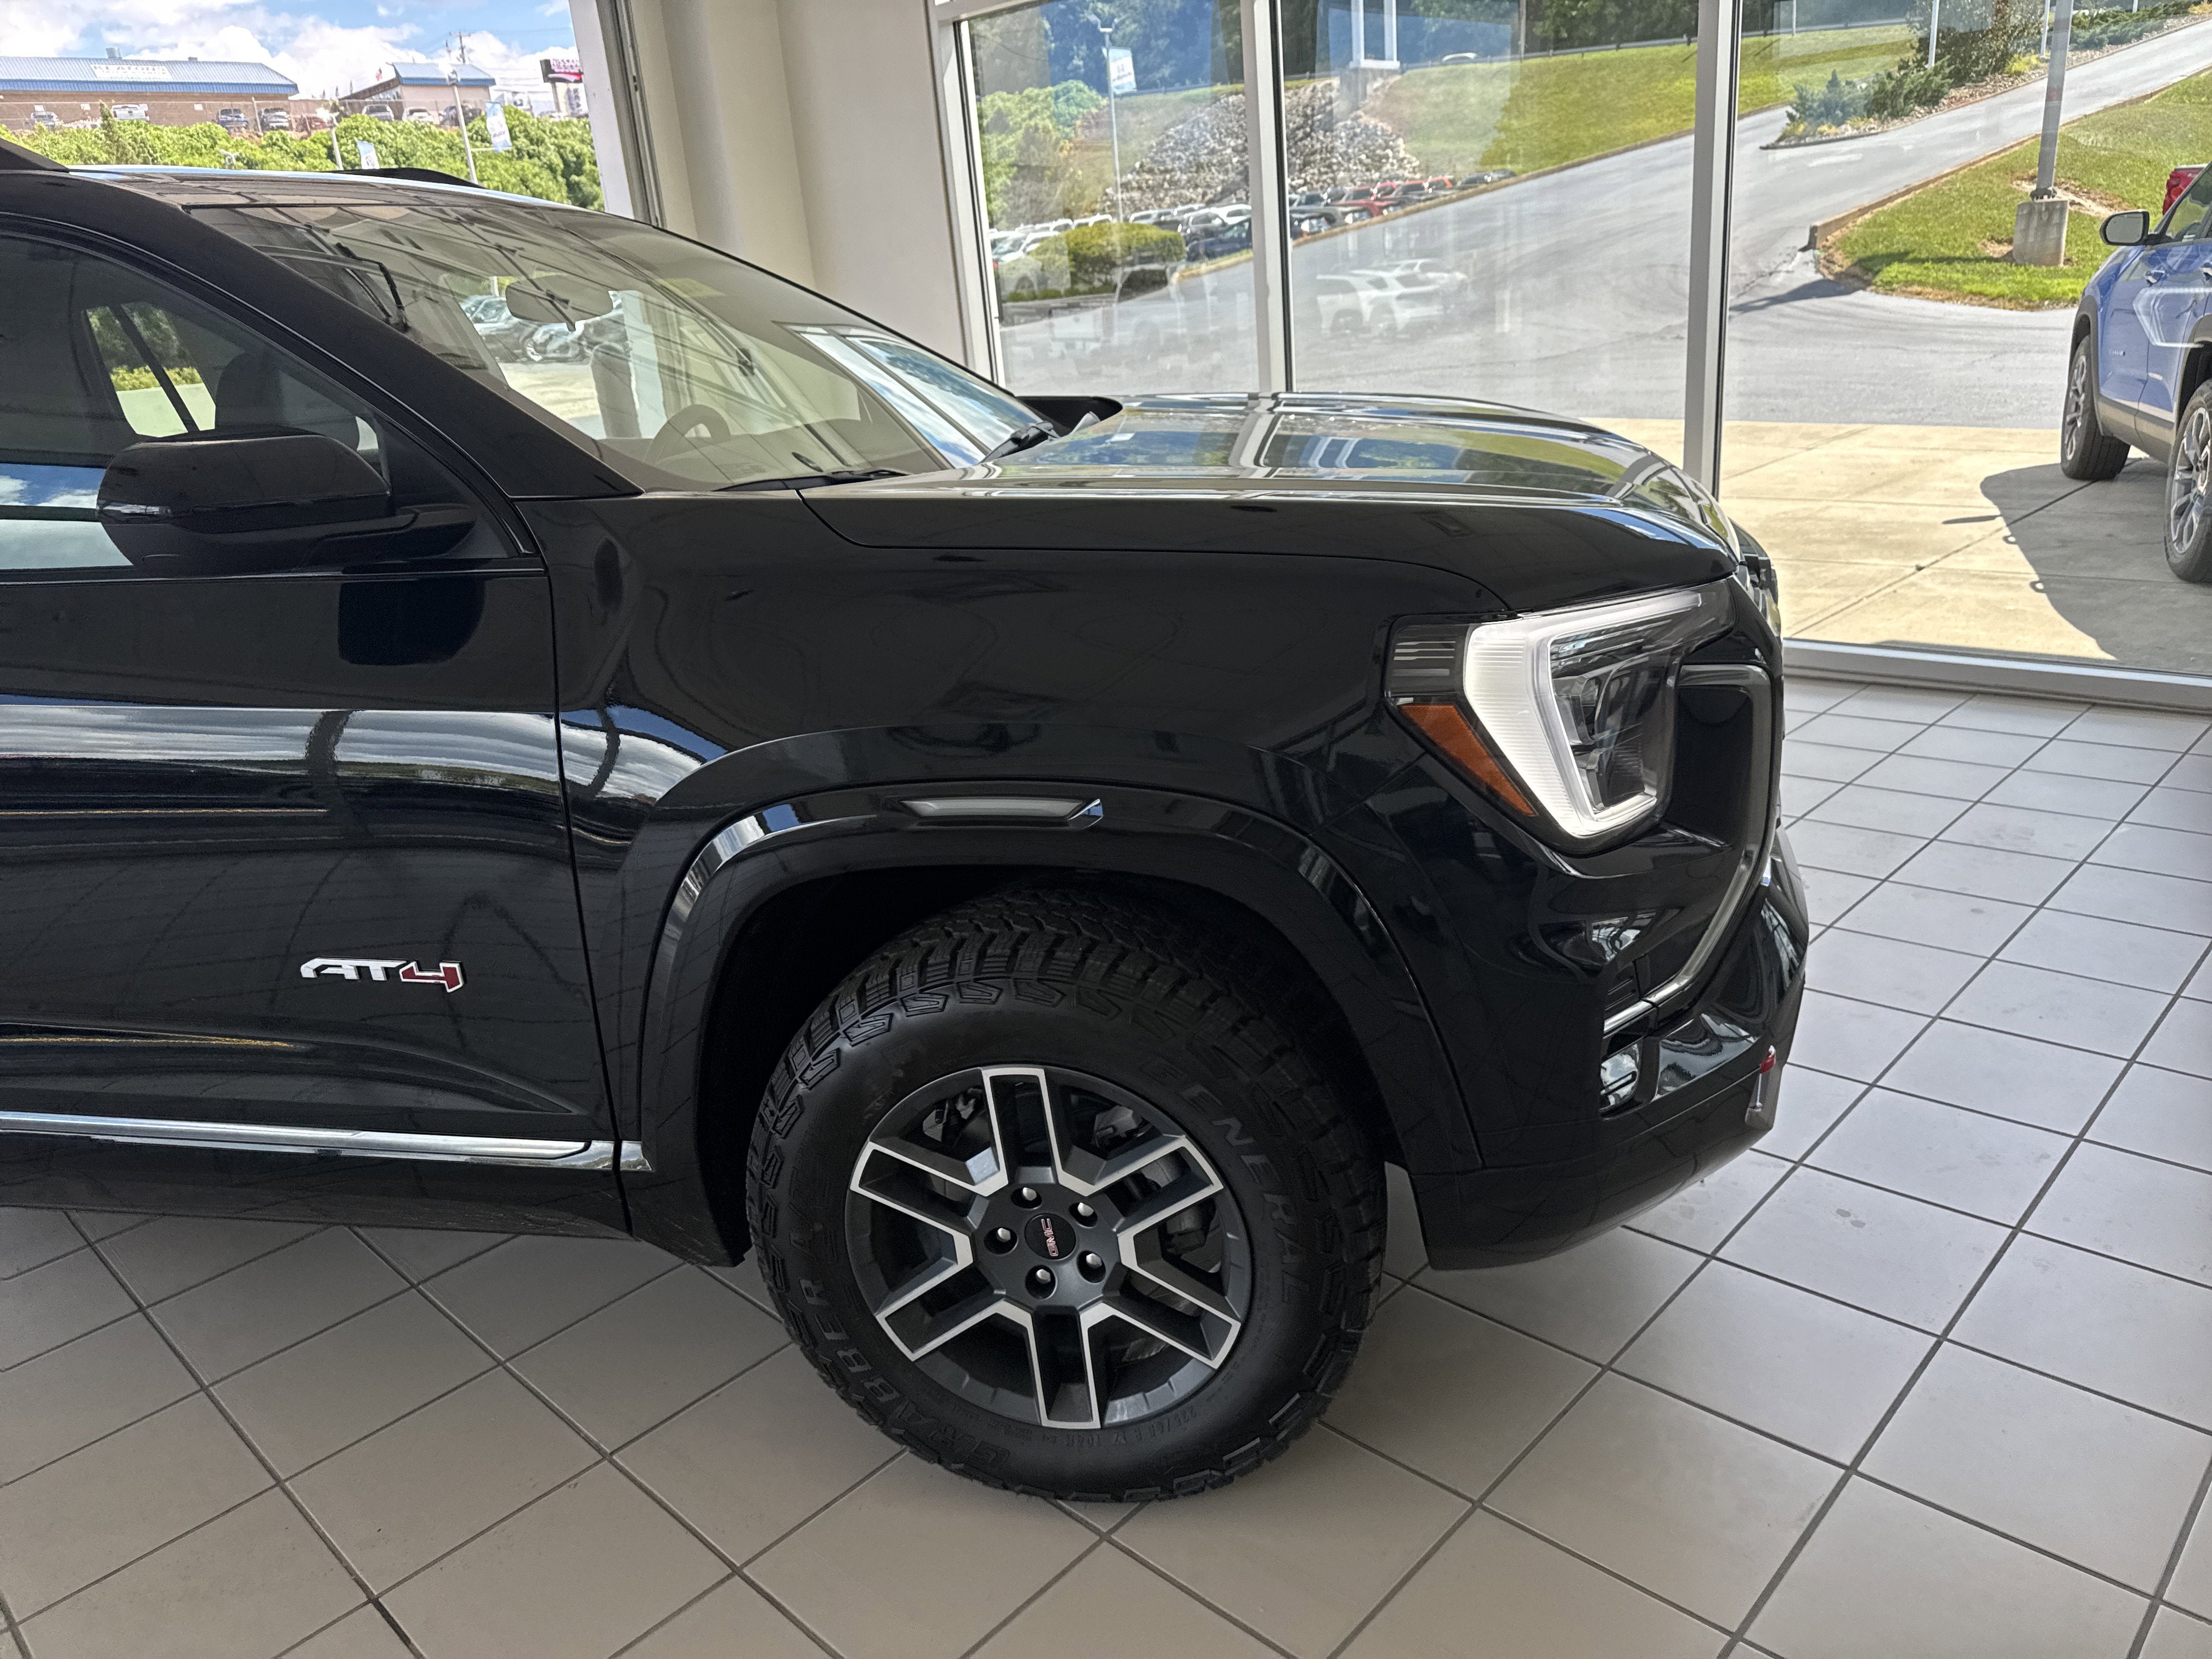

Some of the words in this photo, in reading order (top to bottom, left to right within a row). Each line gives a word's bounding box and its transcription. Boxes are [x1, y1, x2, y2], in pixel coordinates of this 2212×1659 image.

[301, 957, 464, 993] AT4
[1141, 1054, 1310, 1304] GENERAL
[1041, 1218, 1059, 1257] GMC
[799, 1278, 1011, 1462] GRABBER
